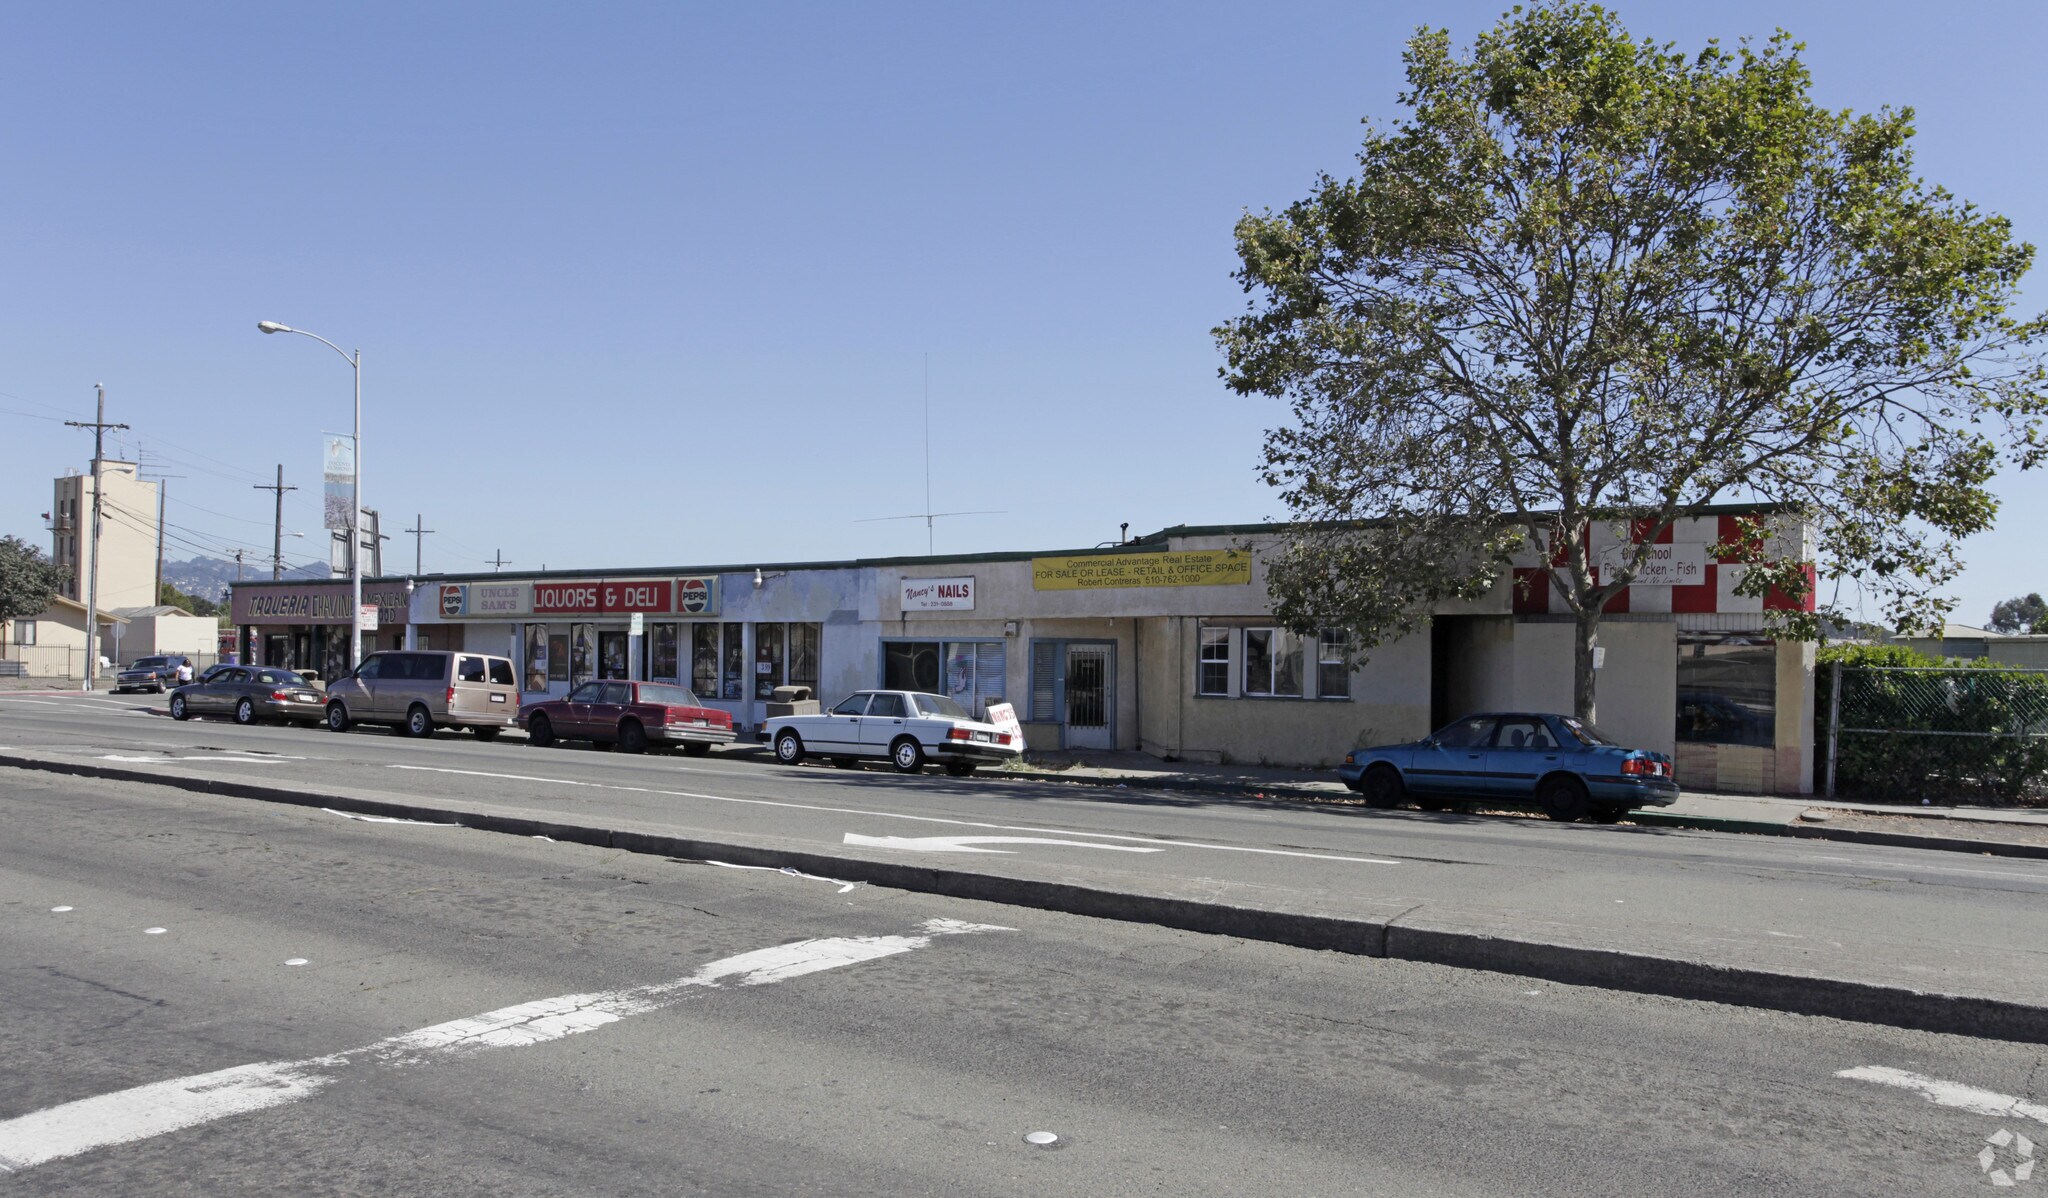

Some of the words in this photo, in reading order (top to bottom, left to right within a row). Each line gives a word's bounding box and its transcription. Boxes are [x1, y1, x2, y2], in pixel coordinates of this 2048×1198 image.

[1066, 559, 1114, 568] Commercial
[1116, 556, 1160, 567] Advantage
[1162, 555, 1183, 564] Real
[1184, 554, 1212, 563] Estate
[1676, 561, 1697, 575] Fish
[1035, 571, 1053, 579] FOR
[1055, 569, 1078, 579] SALE
[1080, 568, 1094, 578] OR
[1096, 567, 1125, 577] LEASE
[1133, 566, 1165, 576] RETAIL
[1167, 566, 1175, 575] &
[1176, 564, 1213, 574] OFFICE
[1214, 562, 1248, 572] SPACE
[1077, 578, 1102, 587] Robert
[1104, 576, 1141, 586] Contreras
[1145, 574, 1200, 585] 510-762-1000
[365, 591, 408, 608] MEXICAN
[480, 587, 520, 598] UNCLE
[534, 587, 597, 608] LIQUORS
[604, 587, 618, 607] &
[624, 586, 658, 607] DELI
[682, 591, 708, 601] PEPSI
[905, 584, 934, 601] Nancy's
[937, 584, 969, 598] NAILS
[248, 595, 310, 617] TAQUERIA
[481, 600, 518, 610] SAM'S
[378, 608, 396, 623] OOD
